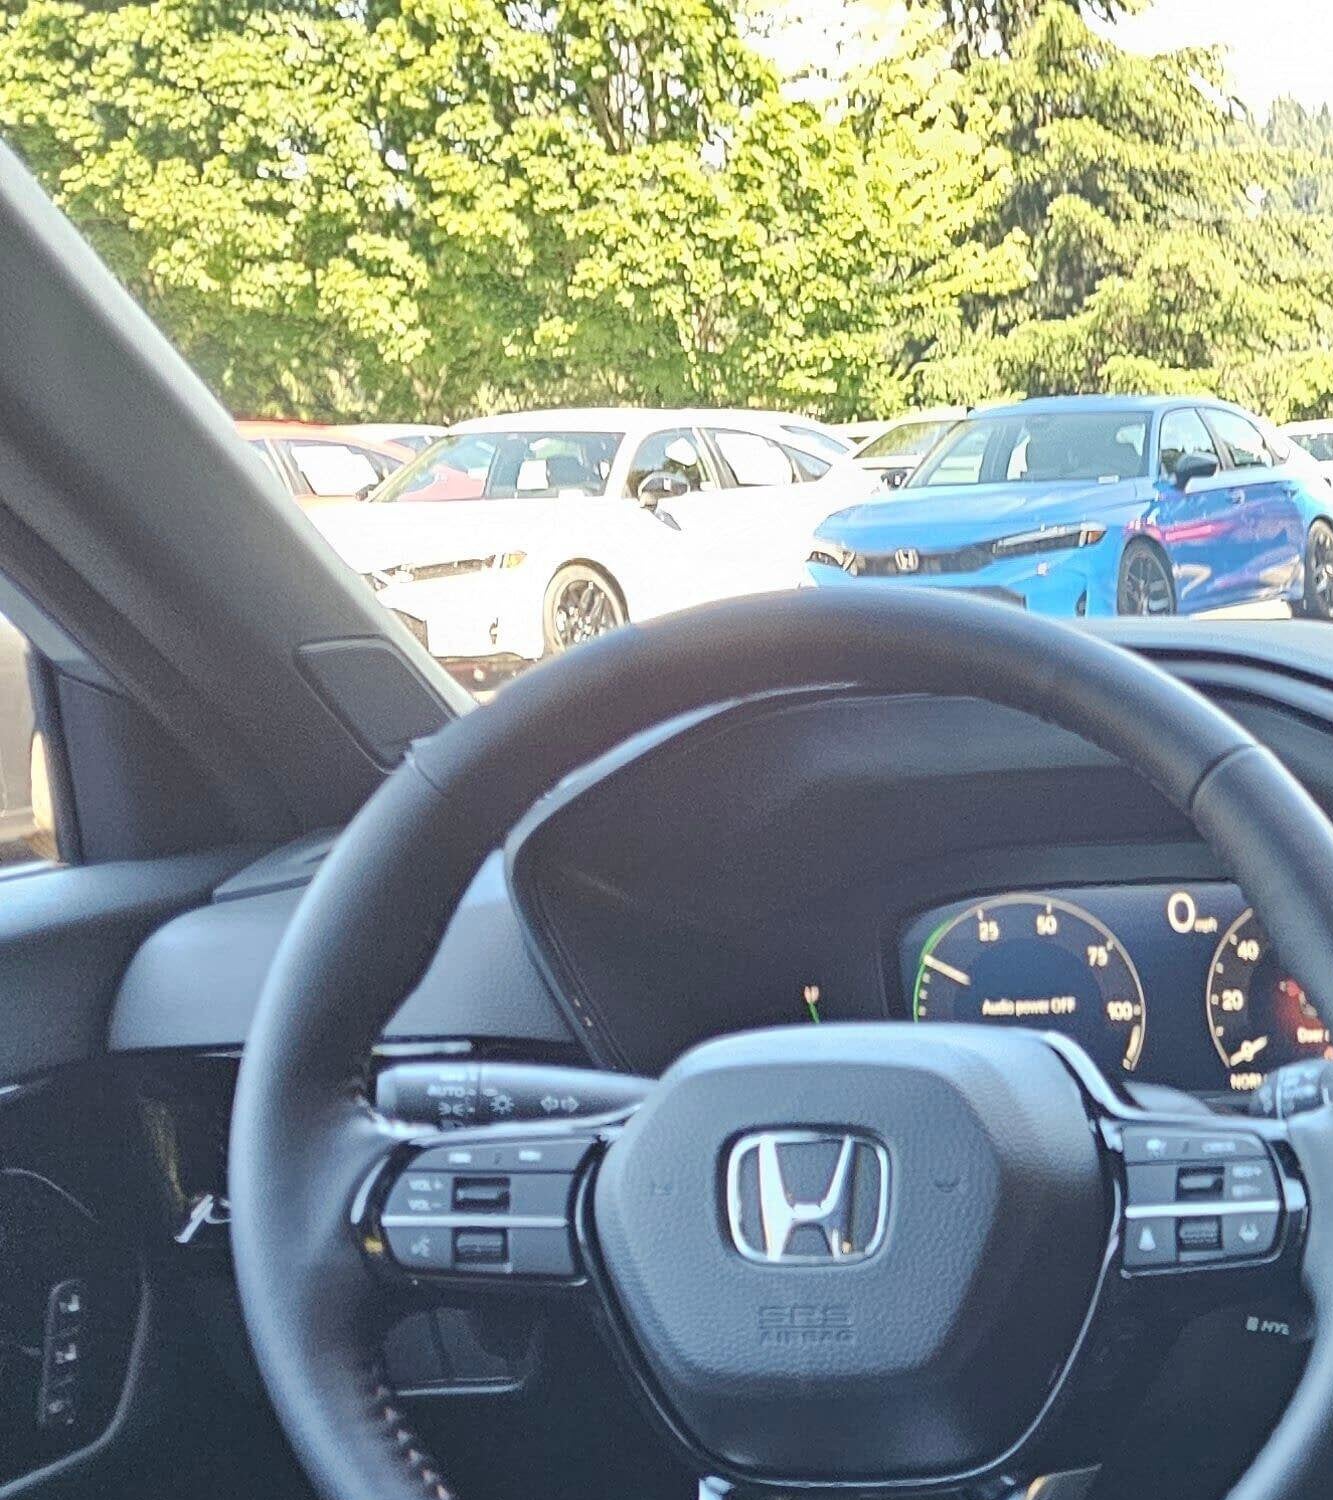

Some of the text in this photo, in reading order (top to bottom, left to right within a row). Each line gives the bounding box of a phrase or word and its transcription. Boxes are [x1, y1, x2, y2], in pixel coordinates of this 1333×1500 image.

[1167, 891, 1196, 934] 0
[979, 920, 1000, 942] 25
[1036, 914, 1058, 936] 50
[1087, 945, 1109, 967] 75
[1237, 939, 1260, 962] 40
[1222, 988, 1244, 1011] 20
[1107, 1001, 1134, 1021] 100
